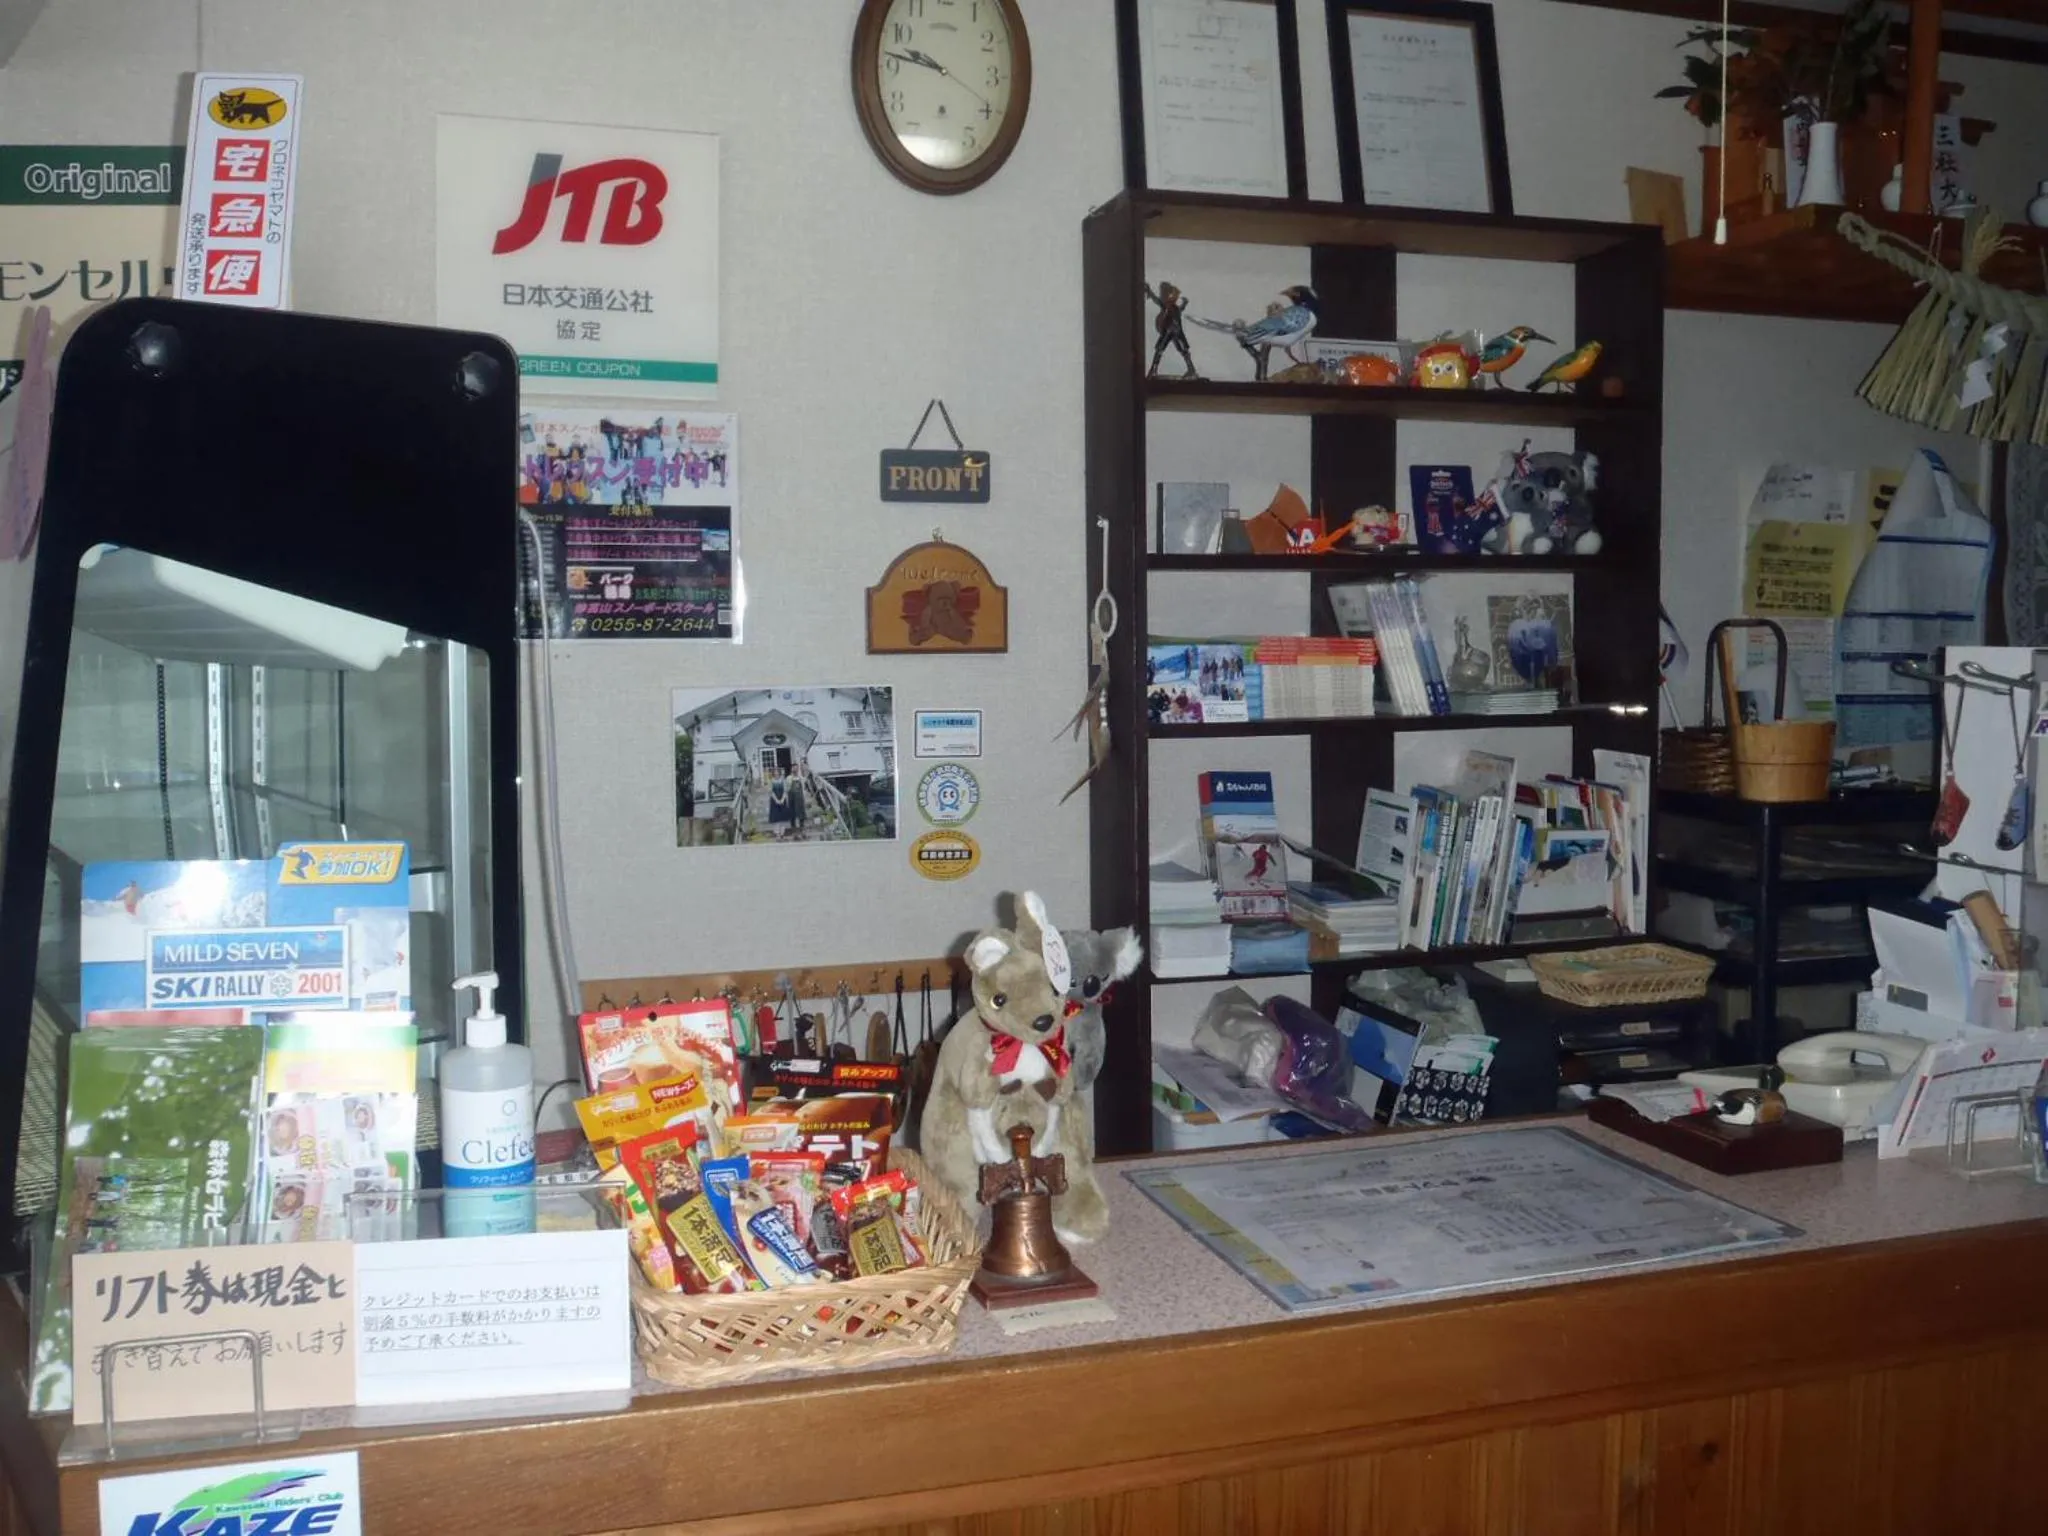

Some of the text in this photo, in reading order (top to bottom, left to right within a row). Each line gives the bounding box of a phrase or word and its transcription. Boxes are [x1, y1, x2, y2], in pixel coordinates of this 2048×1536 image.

[895, 22, 912, 44] 10
[980, 31, 993, 52] 2
[886, 57, 900, 75] 9
[985, 65, 999, 88] 3
[890, 90, 904, 112] 8
[962, 126, 976, 148] 5
[25, 164, 171, 198] Original
[492, 152, 668, 255] JTB
[209, 144, 264, 291] 宅急便
[503, 283, 654, 314] 日本交通公社
[556, 319, 601, 341] 協定
[577, 361, 641, 376] COUPON
[889, 465, 984, 493] FRONT
[591, 617, 715, 632] 0255-87-2644
[164, 942, 299, 963] MILD SEVEN
[152, 972, 342, 1000] SKI RALLY 2001
[96, 1260, 347, 1322] リフト券は現金と
[317, 1491, 344, 1502] Club
[127, 1503, 343, 1536] KAZE
